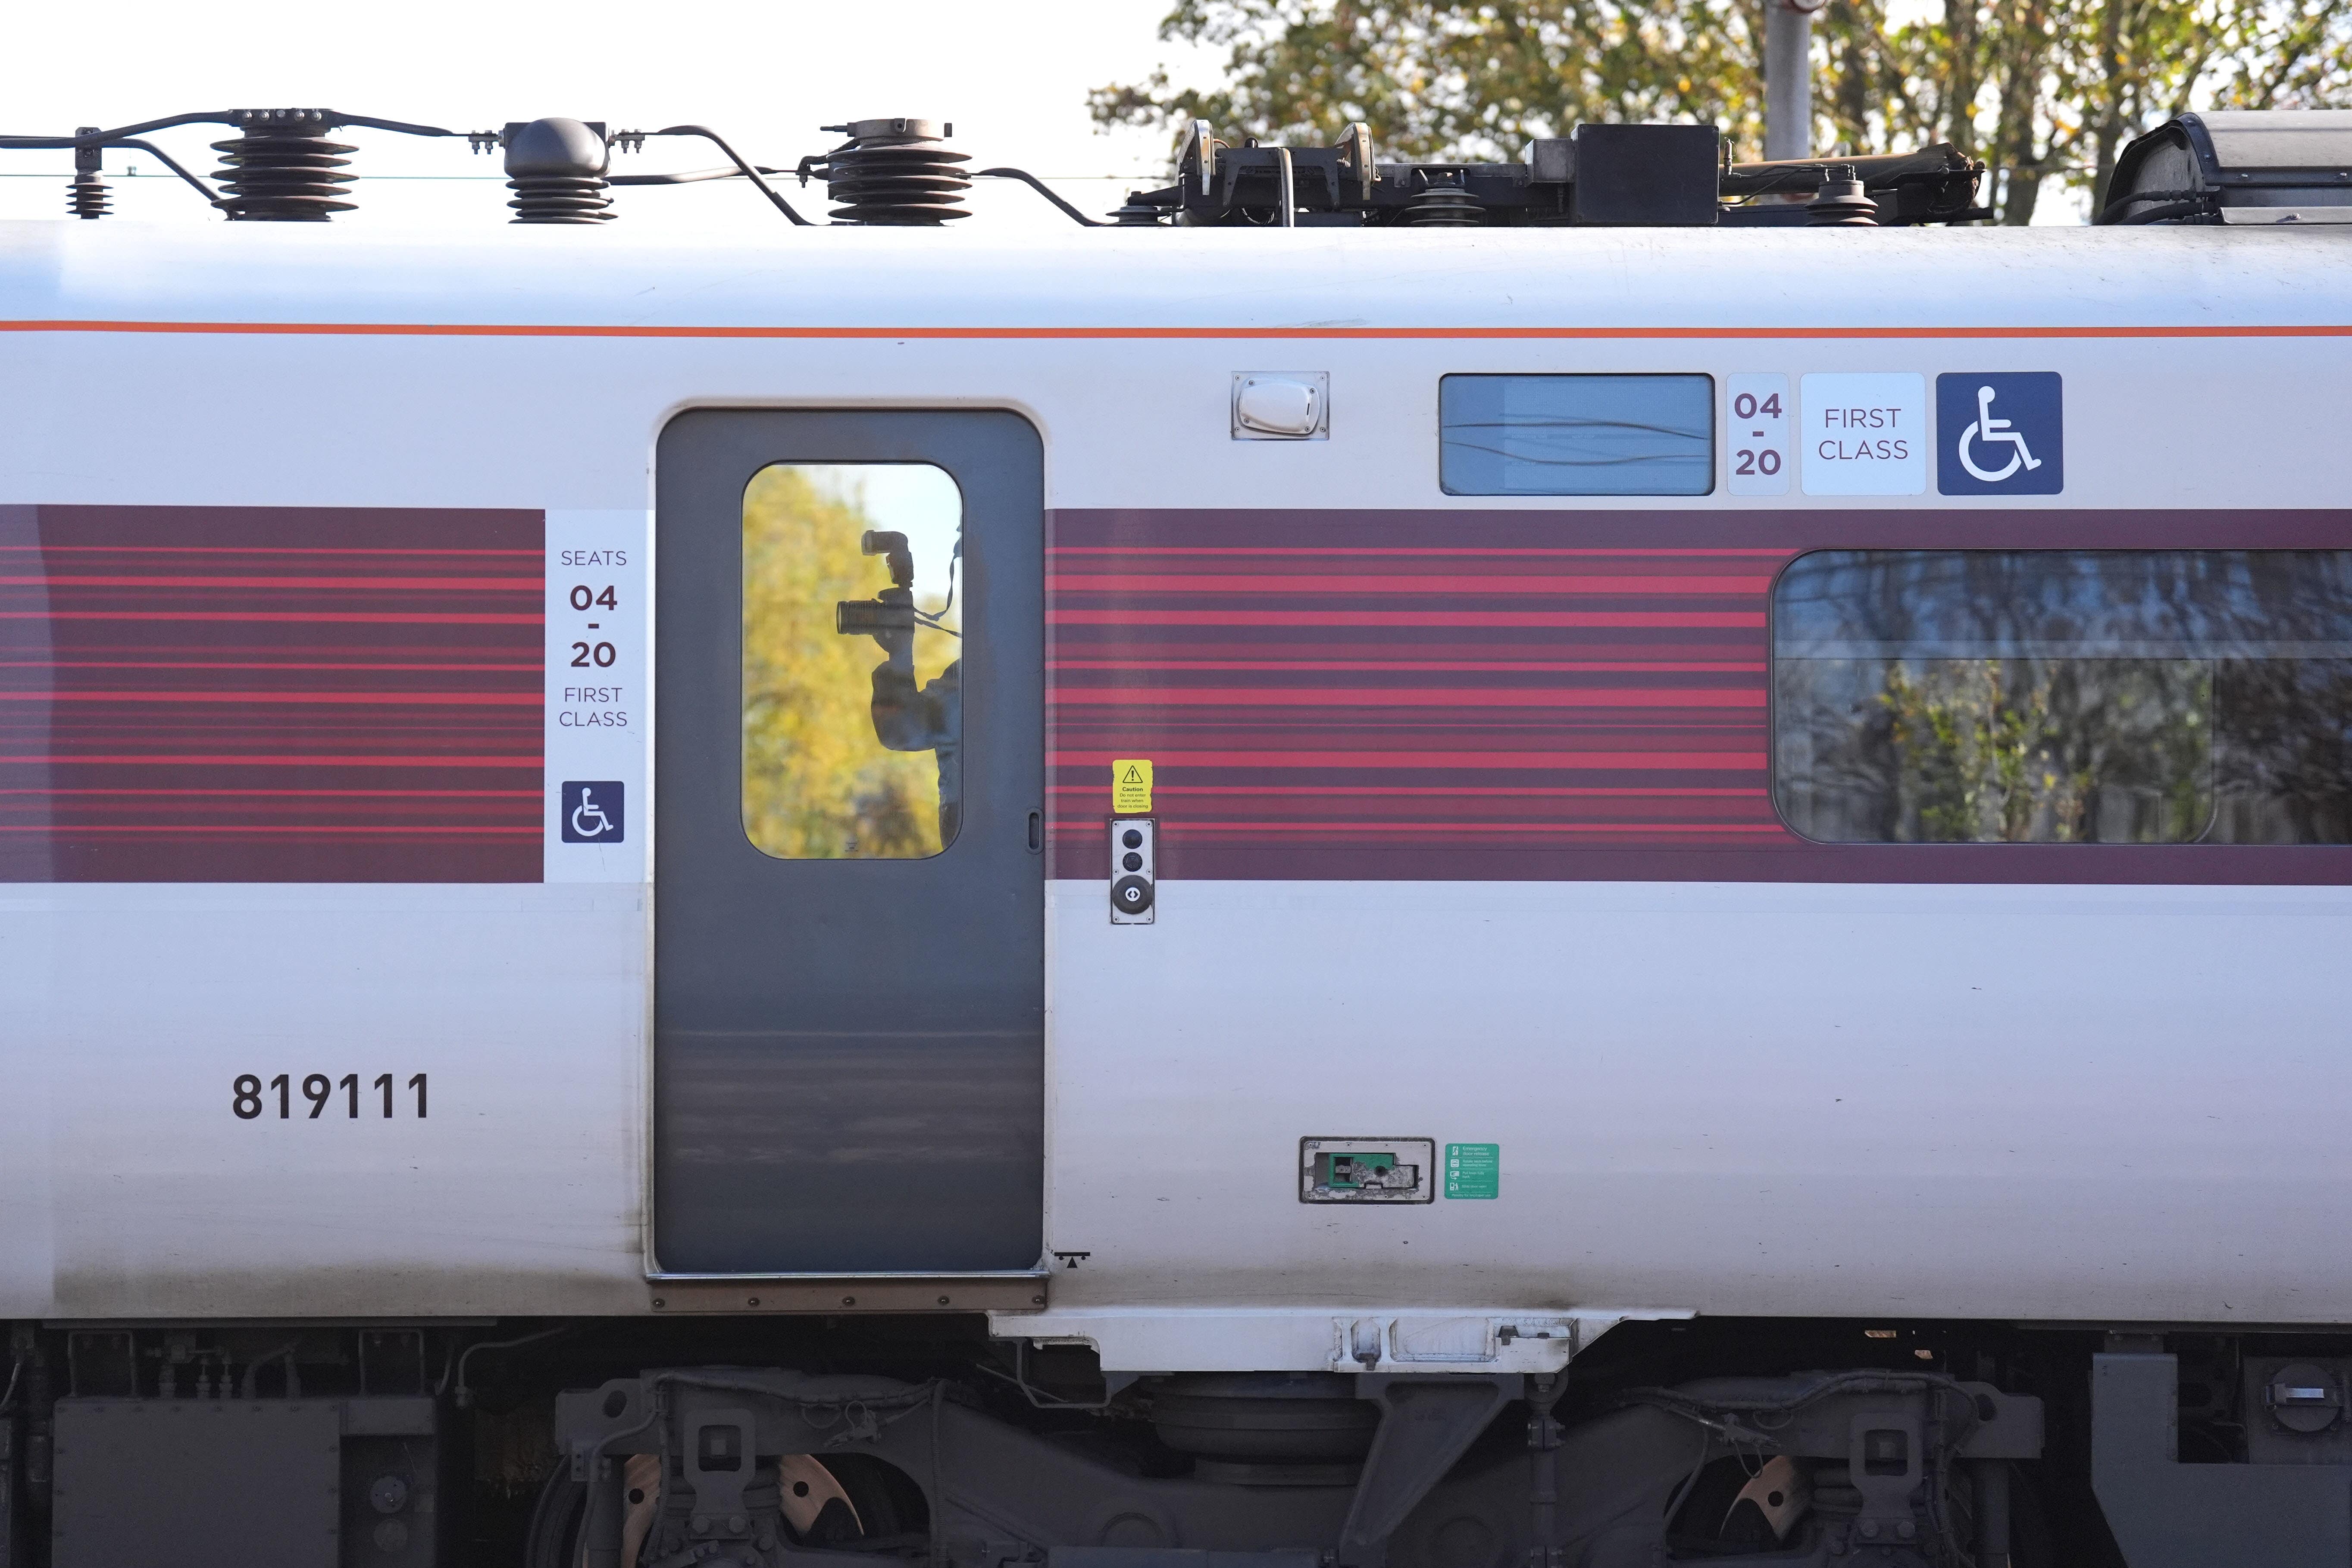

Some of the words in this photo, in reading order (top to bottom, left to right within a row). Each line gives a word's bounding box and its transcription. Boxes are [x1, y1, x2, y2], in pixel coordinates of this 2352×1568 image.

[1734, 393, 1782, 419] 04
[1826, 408, 1902, 428] FIRST
[1819, 440, 1908, 460] CLASS
[1736, 449, 1781, 476] 20
[561, 551, 626, 566] SEATS
[570, 585, 617, 611] 04
[571, 642, 616, 668] 20
[565, 687, 622, 702] FIRST
[560, 711, 627, 726] CLASS
[233, 1073, 427, 1120] 819111
